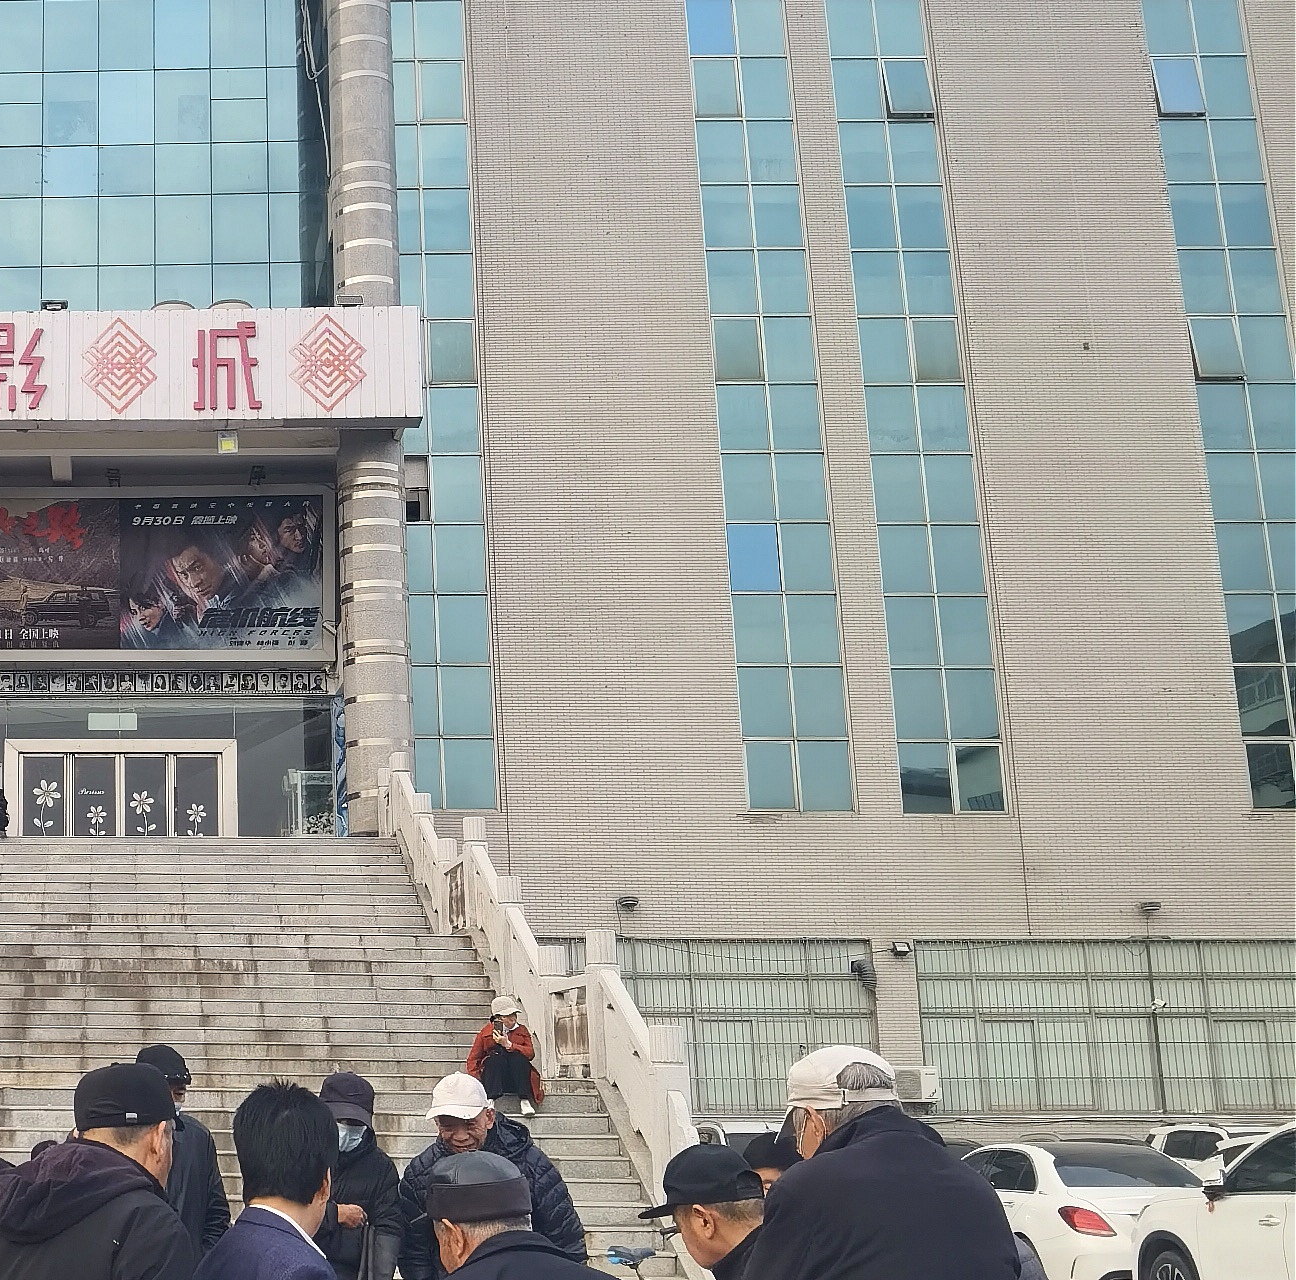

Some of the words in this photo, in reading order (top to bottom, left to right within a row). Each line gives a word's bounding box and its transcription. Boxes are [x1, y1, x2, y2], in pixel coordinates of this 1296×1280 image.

[131, 515, 186, 526] 9月30日
[19, 628, 60, 640] 全国上映
[198, 629, 238, 637] HIGH
